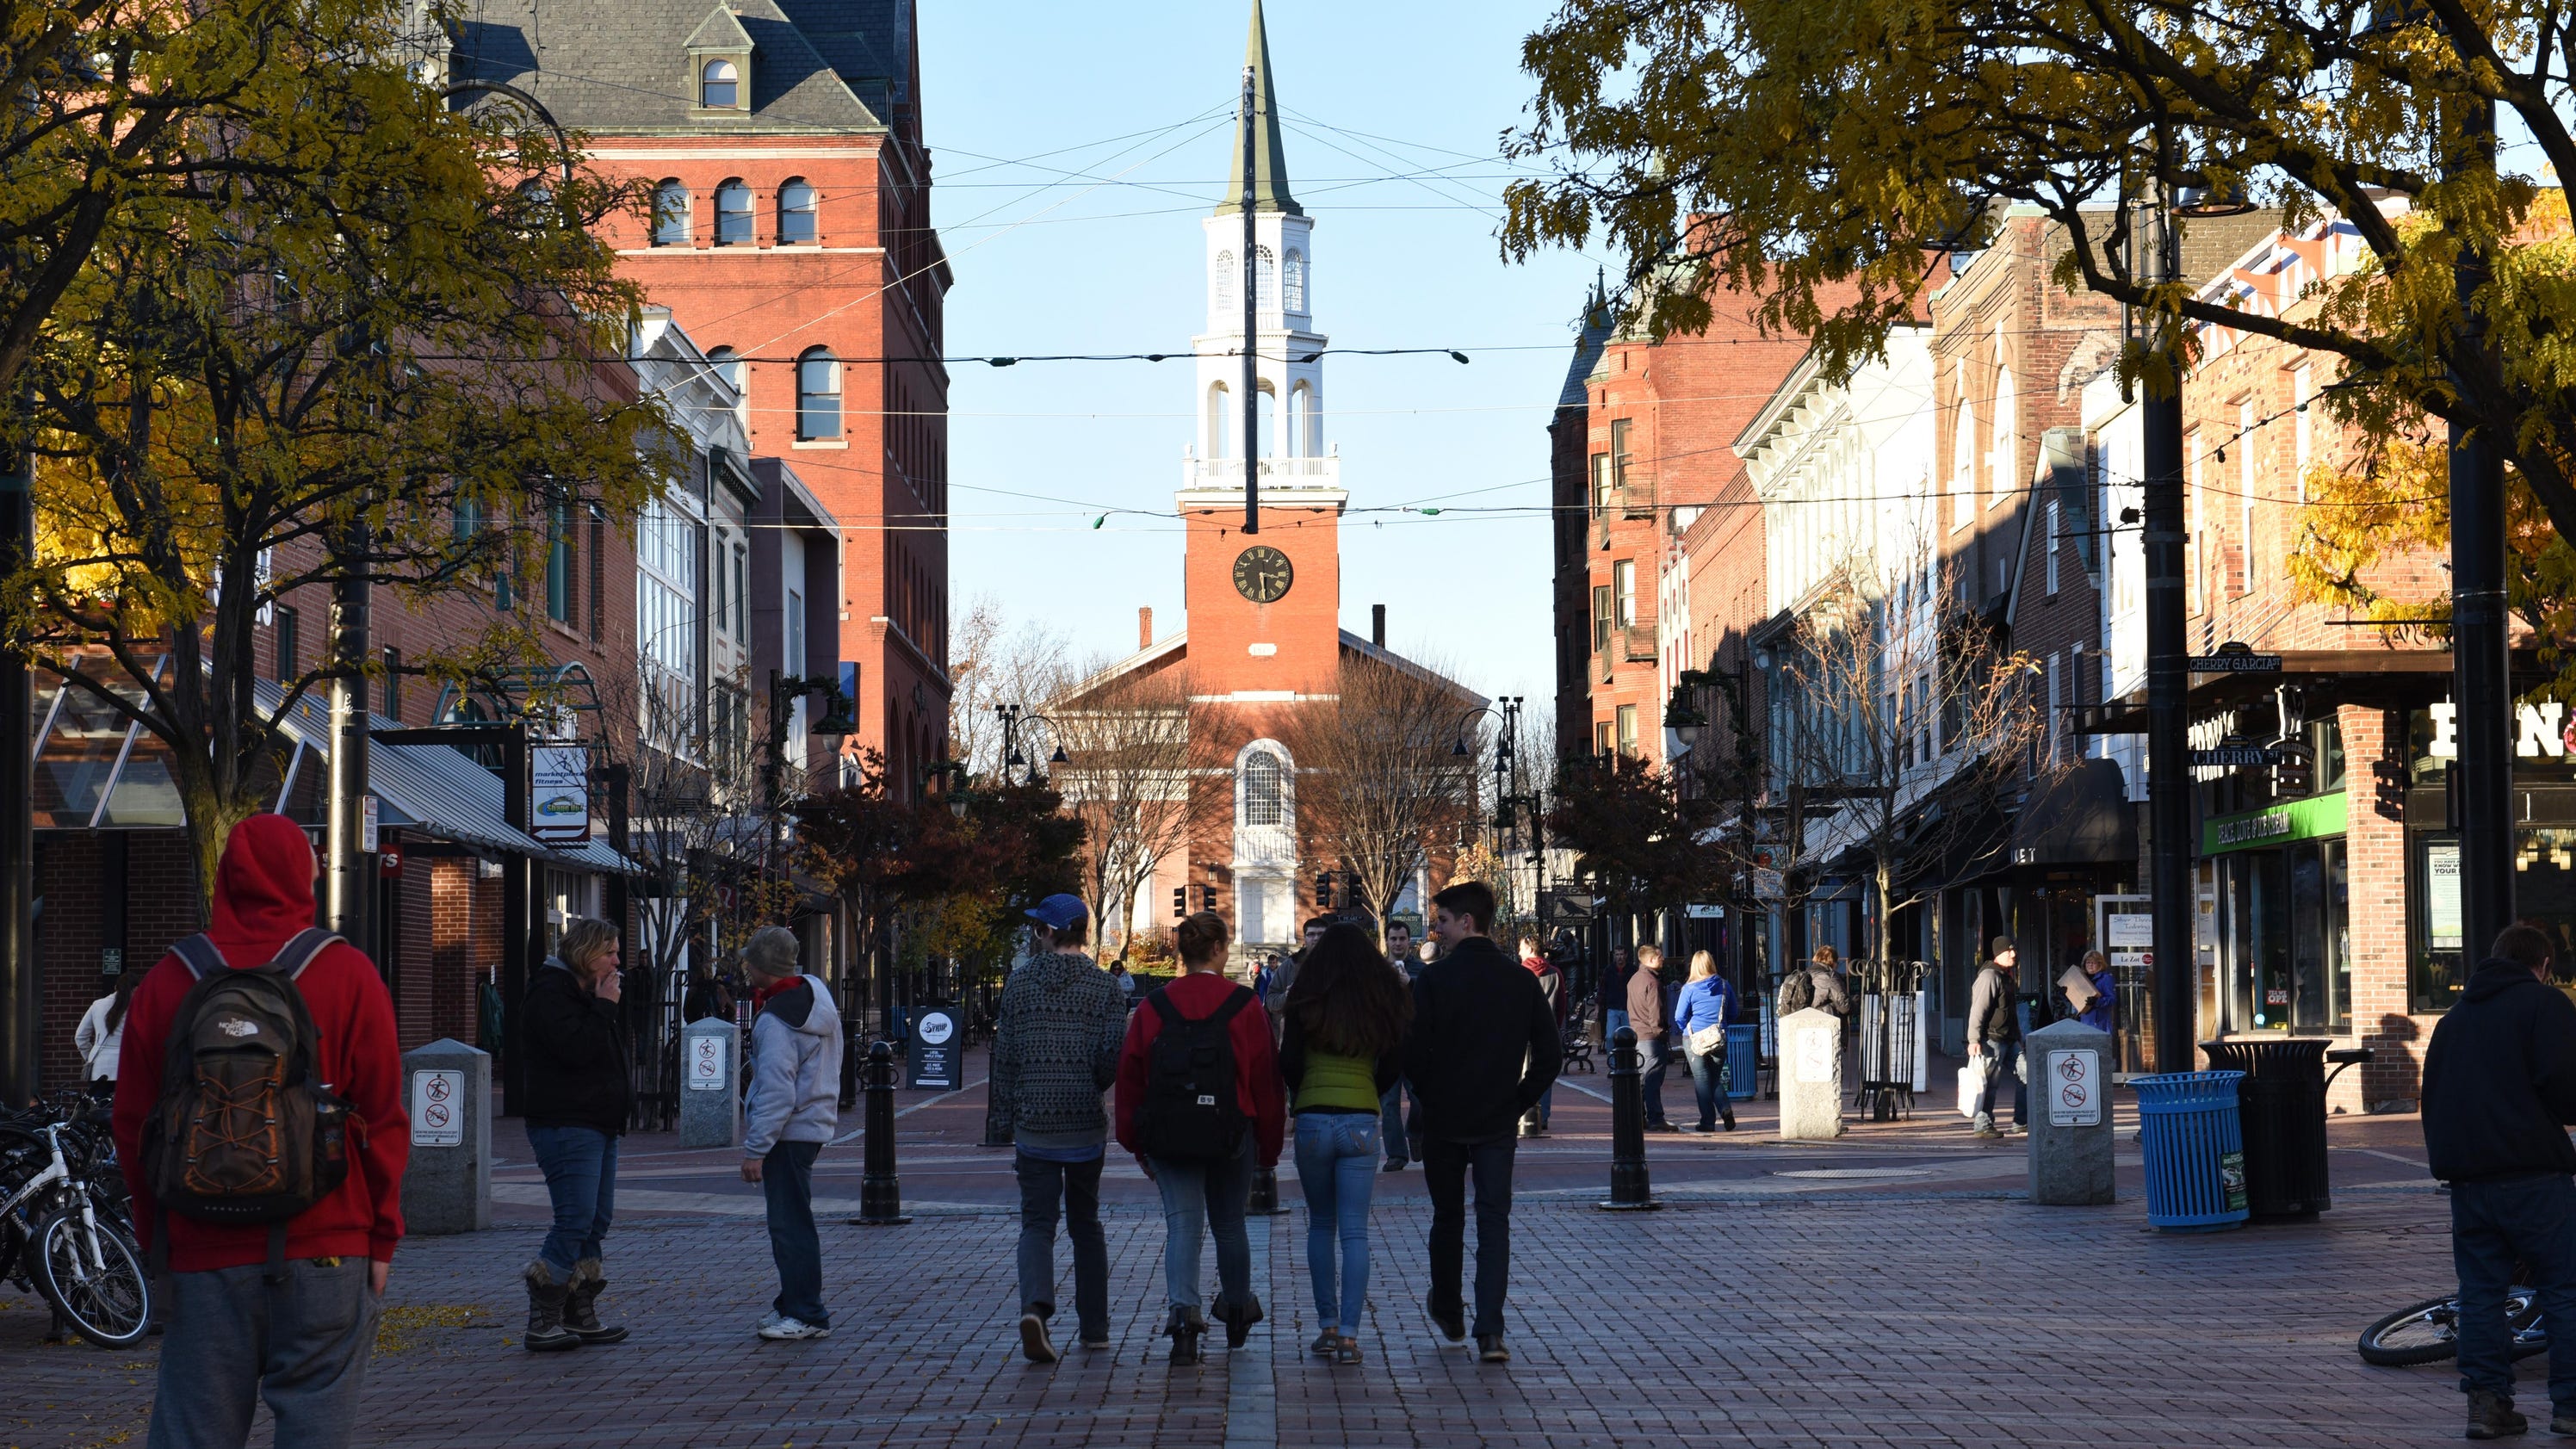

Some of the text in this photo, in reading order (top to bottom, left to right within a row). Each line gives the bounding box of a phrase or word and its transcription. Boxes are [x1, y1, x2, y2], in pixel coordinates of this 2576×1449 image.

[2189, 658, 2230, 670] CHERRY
[2232, 658, 2274, 670] GARCIA
[2193, 750, 2280, 765] CHERRY ST
[2218, 822, 2236, 845] PEACE,
[2237, 819, 2251, 841] LOVE
[2257, 814, 2268, 837] ICE
[2268, 811, 2289, 835] CREAM
